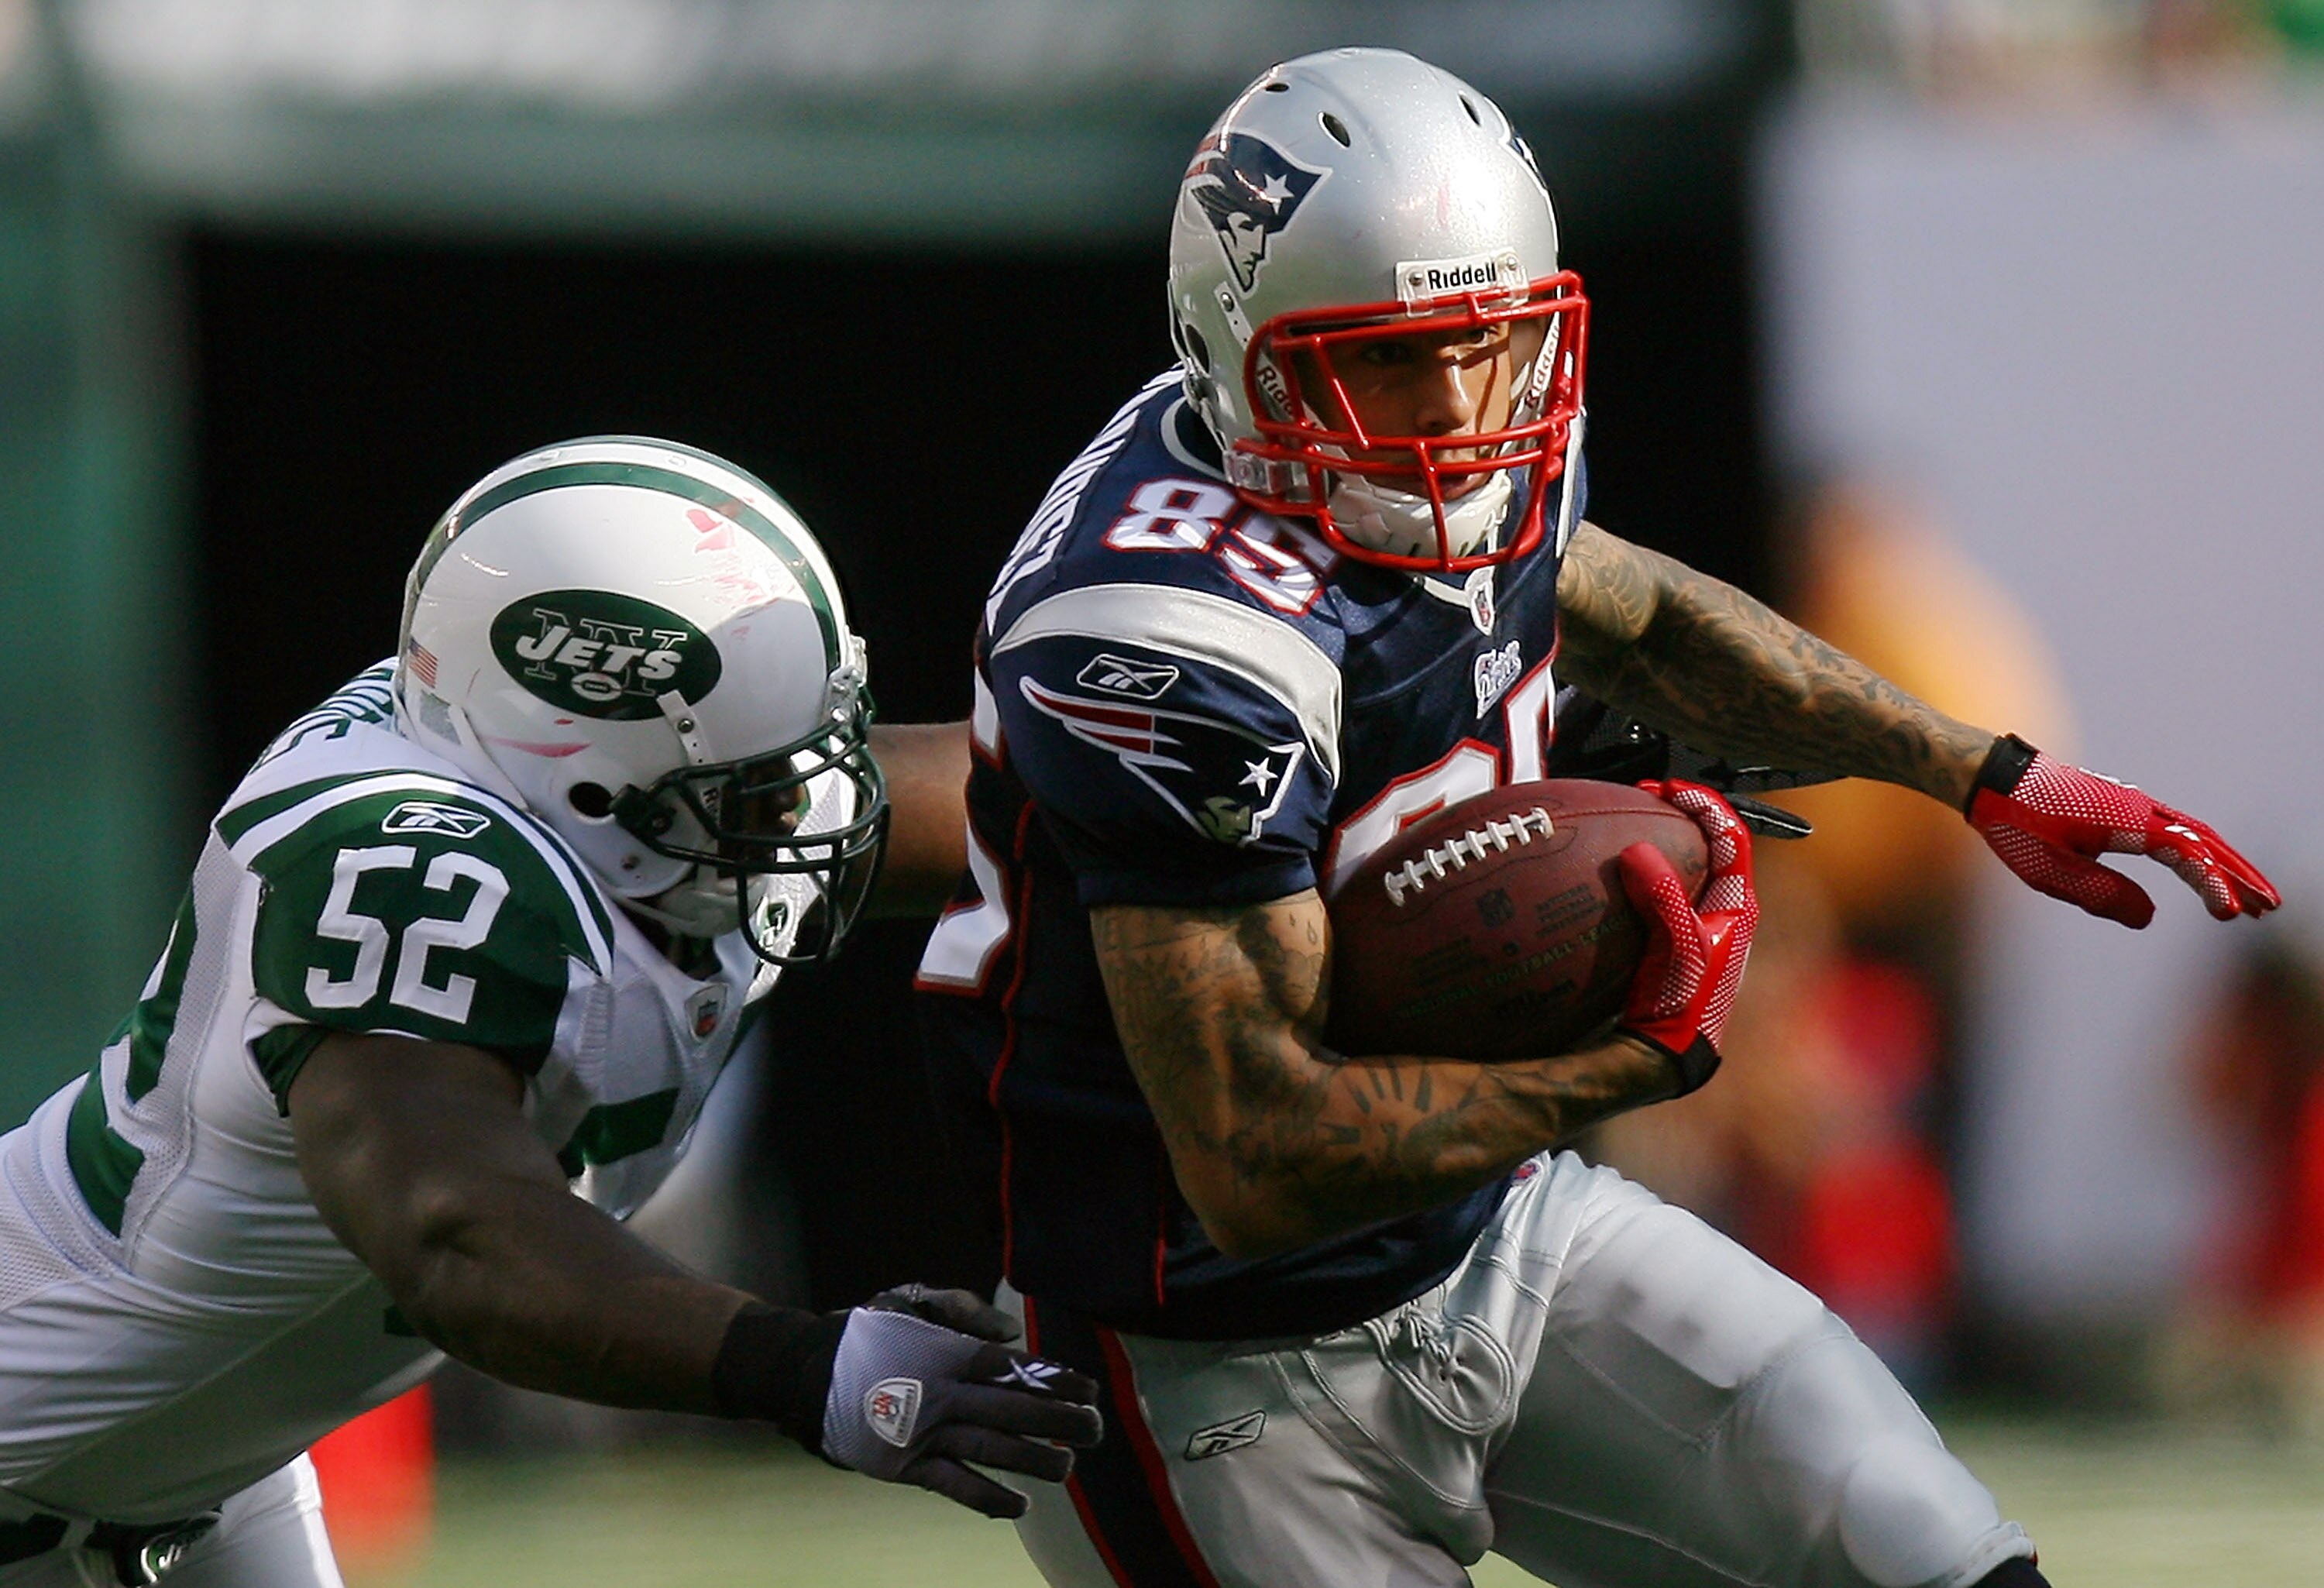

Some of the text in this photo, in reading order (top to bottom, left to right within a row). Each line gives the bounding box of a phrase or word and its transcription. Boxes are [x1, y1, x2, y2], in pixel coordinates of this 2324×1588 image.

[1428, 260, 1497, 290] Riddell
[1100, 474, 1344, 616] 85
[515, 624, 682, 680] JETS
[304, 845, 511, 1025] 52
